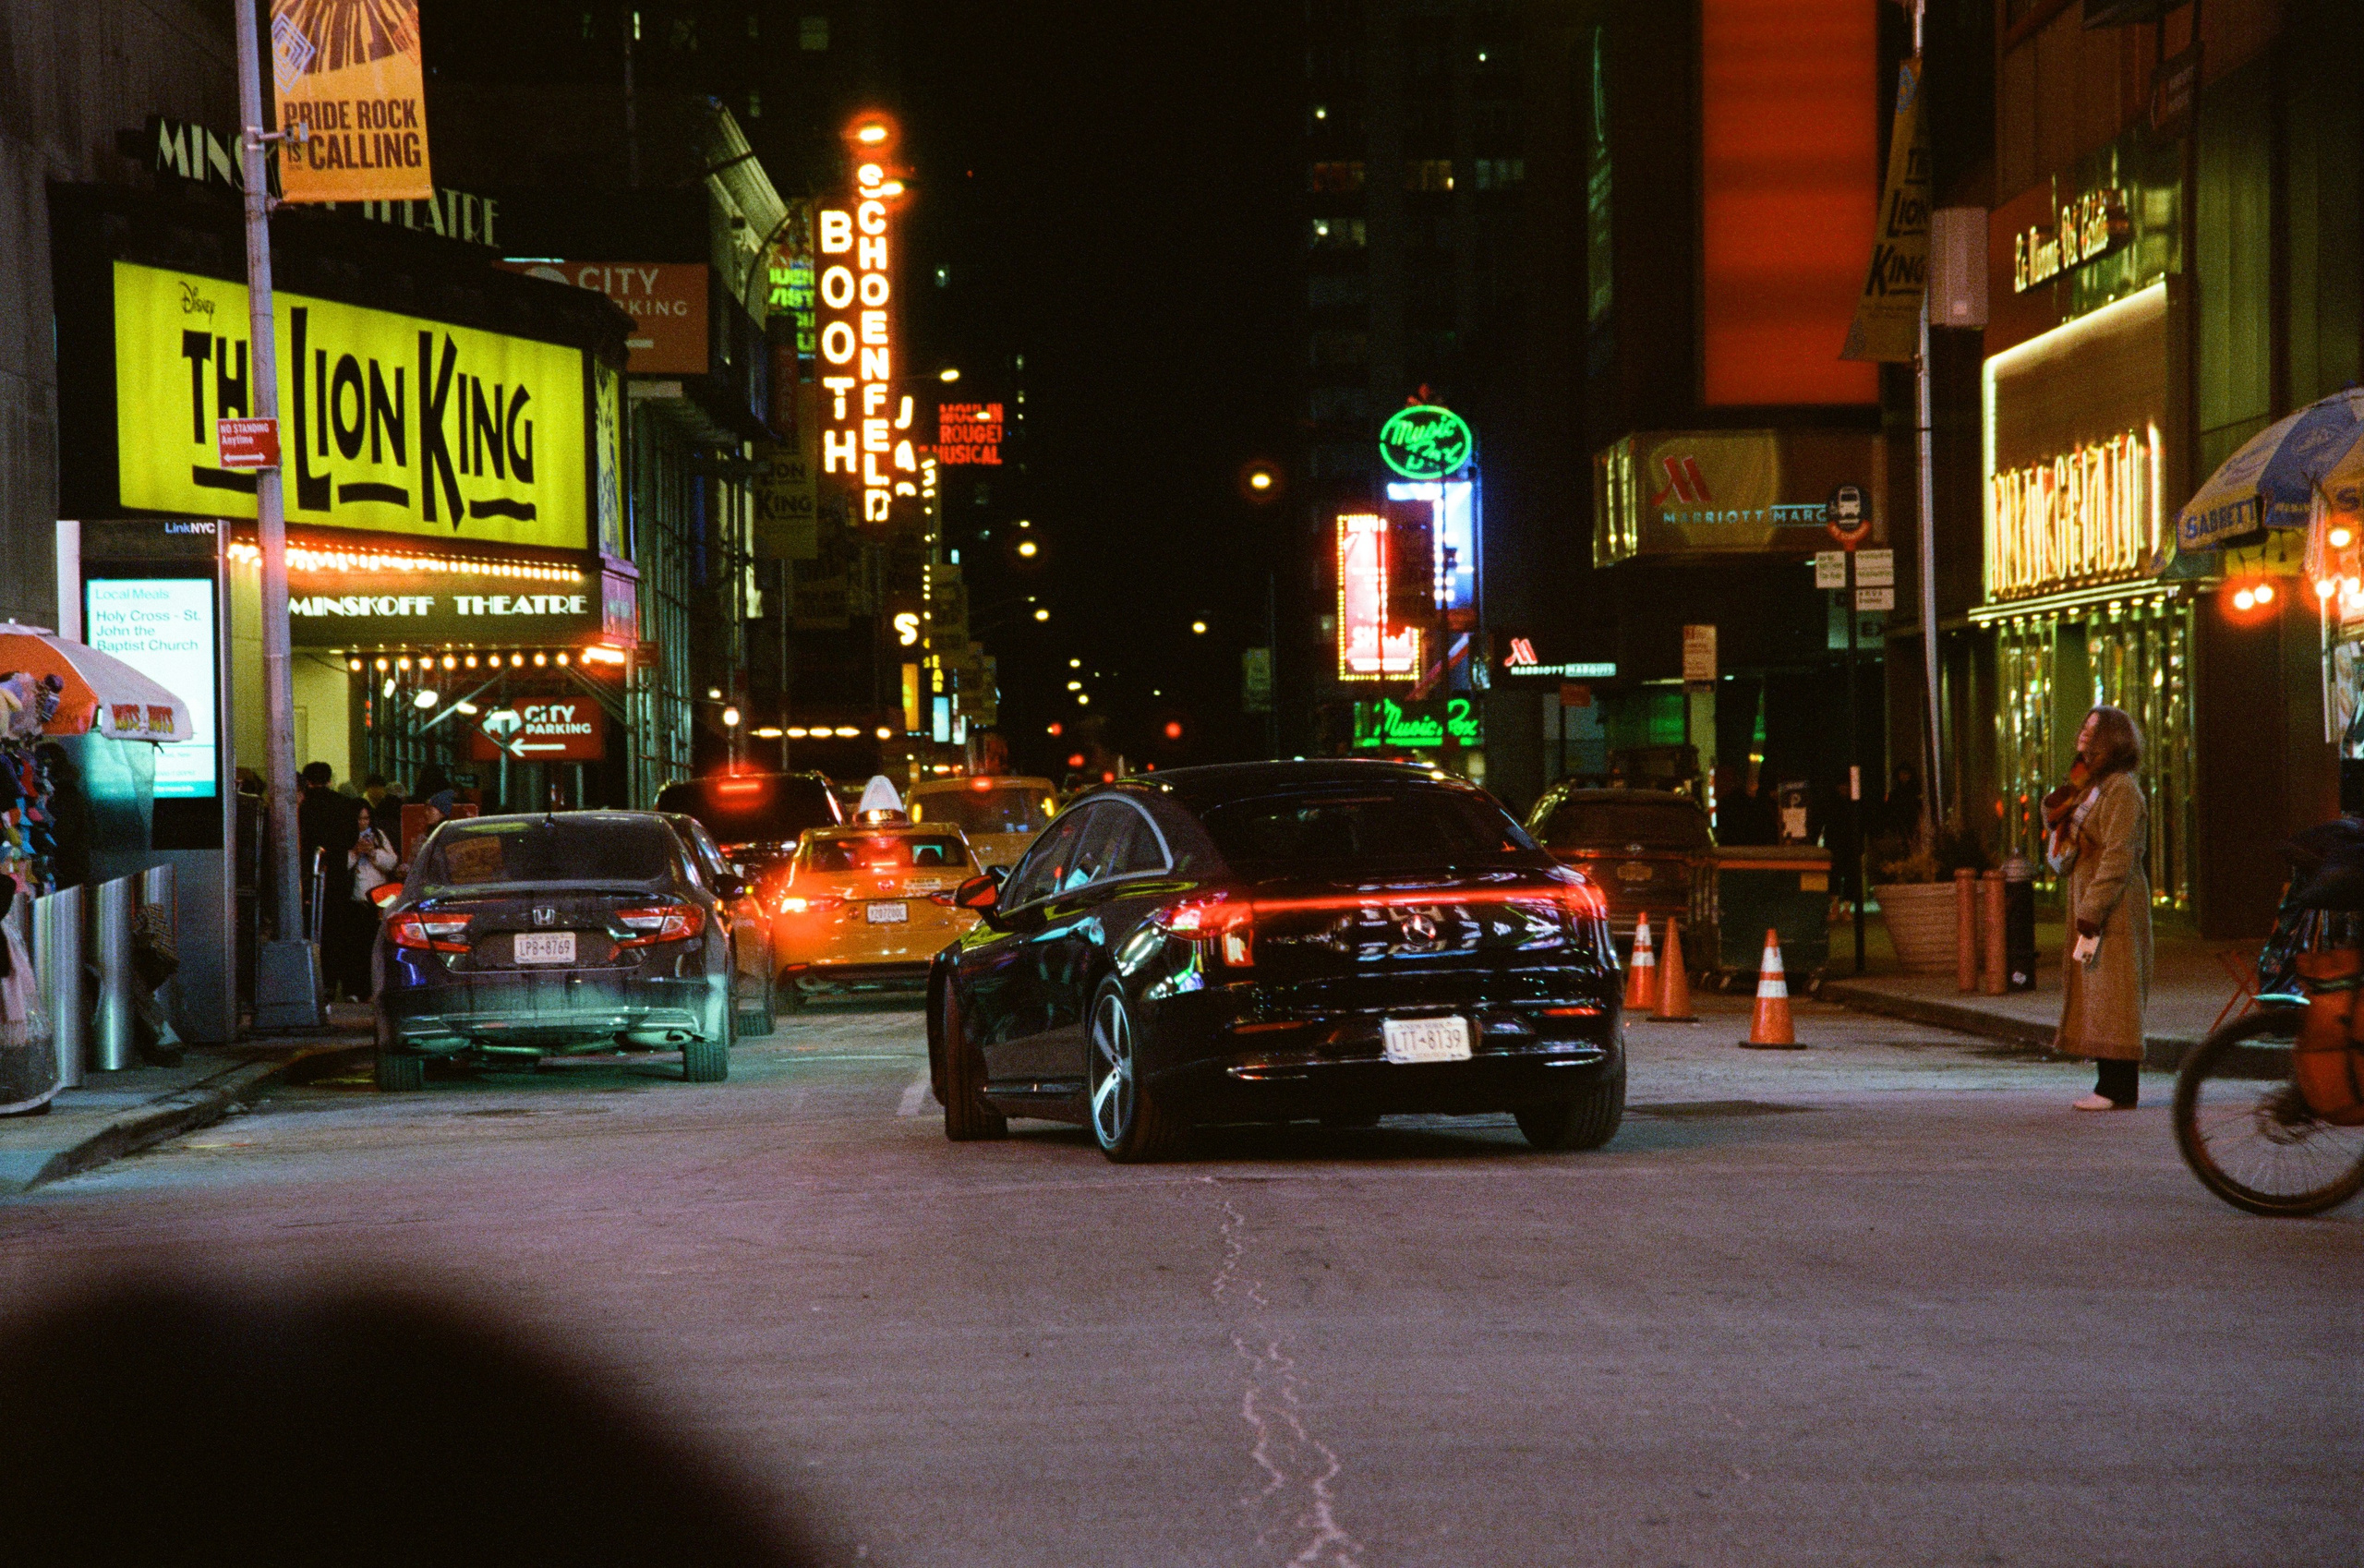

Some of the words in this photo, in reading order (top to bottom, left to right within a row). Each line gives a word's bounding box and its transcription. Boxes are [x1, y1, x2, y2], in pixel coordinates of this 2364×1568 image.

[283, 100, 350, 130] PRIDE
[356, 98, 418, 129] ROCK
[308, 132, 422, 170] CALLING
[577, 266, 659, 295] CITY
[1864, 244, 1926, 297] KING
[178, 281, 216, 323] Disney
[820, 210, 856, 473] BOOTH
[858, 163, 891, 522] SCHOENFELD
[182, 329, 255, 444] TH
[290, 307, 407, 513] LION
[418, 331, 536, 532] KING
[221, 423, 233, 434] NO
[233, 422, 270, 434] STANDING
[222, 435, 254, 446] Anytime
[1391, 415, 1458, 446] Music
[1662, 510, 1764, 525] MARRIOTT
[2185, 498, 2255, 539] SABRETT
[164, 522, 216, 535] LinkNYC
[95, 588, 130, 600] Local
[132, 588, 169, 600] Meals
[96, 609, 126, 623] Holy
[130, 609, 170, 621] Cross
[183, 609, 201, 621] St.
[287, 596, 435, 618] MINSKOFF
[452, 595, 588, 616] THEATRE
[96, 626, 130, 637] John
[135, 625, 156, 637] the
[97, 640, 145, 654] Baptist
[149, 639, 199, 652] Church
[1511, 665, 1564, 676] MARRIOTT
[525, 705, 576, 723] CITY
[525, 723, 593, 736] PARKING
